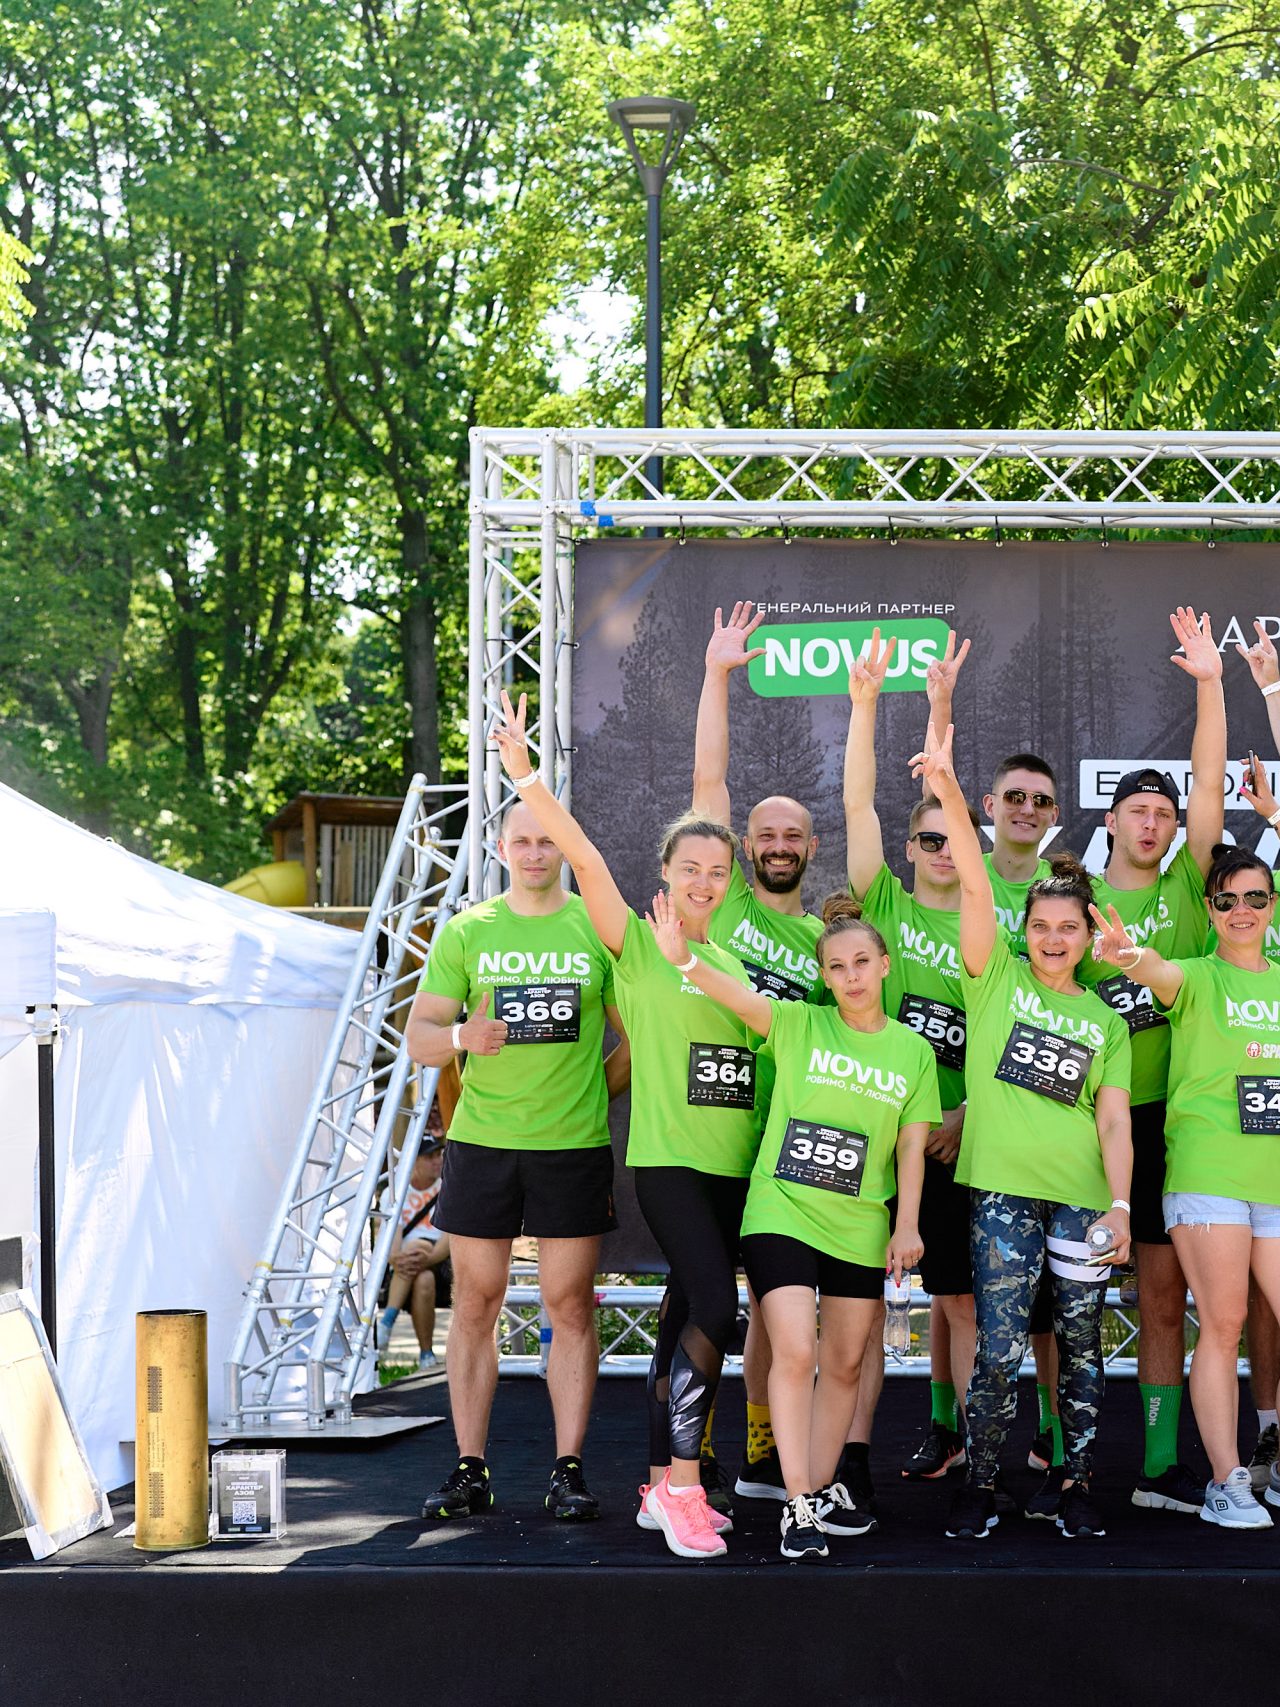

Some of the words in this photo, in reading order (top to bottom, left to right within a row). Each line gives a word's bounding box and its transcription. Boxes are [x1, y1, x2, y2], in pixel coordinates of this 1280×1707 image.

[878, 603, 955, 614] ПАРТНЕР
[765, 638, 938, 678] NOVUS
[733, 918, 819, 981] NOVUS
[898, 921, 960, 969] NOVU
[478, 951, 591, 975] NOVUS
[939, 967, 960, 979] ЛЮБ
[478, 976, 522, 985] РОБИМО,
[543, 976, 591, 985] ЛЮБИМО
[774, 967, 814, 991] ЛЮБИМО
[502, 1000, 573, 1022] 366
[1111, 986, 1153, 1014] 34
[903, 1012, 965, 1046] 350
[696, 1061, 751, 1085] 364
[808, 1048, 907, 1099] NOVUS
[1010, 1041, 1081, 1081] 336
[805, 1075, 847, 1091] РОБИМО,
[850, 1084, 863, 1094] БО
[864, 1089, 902, 1110] ЛЮБИМО
[789, 1138, 859, 1171] 359
[1149, 1397, 1161, 1426] NOVUS
